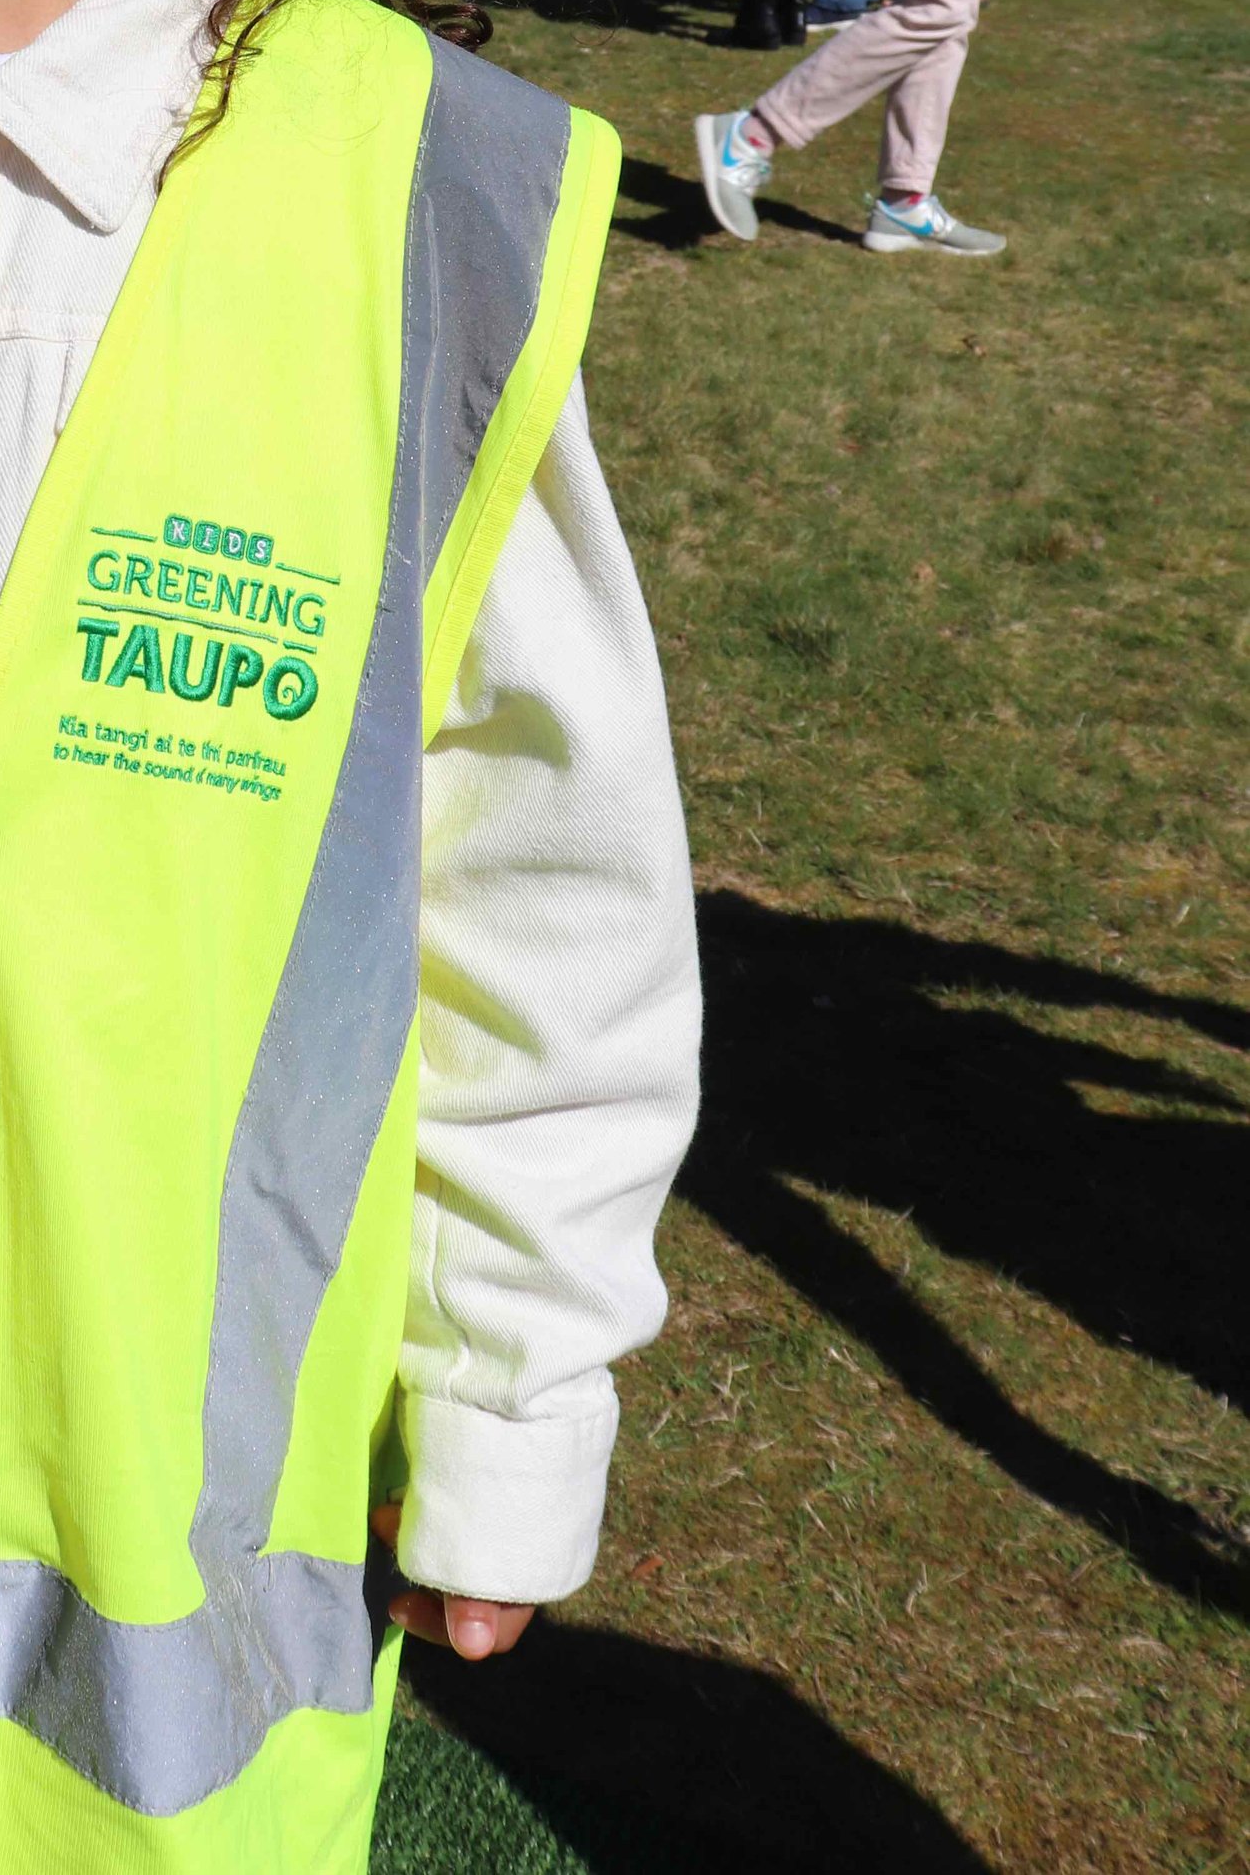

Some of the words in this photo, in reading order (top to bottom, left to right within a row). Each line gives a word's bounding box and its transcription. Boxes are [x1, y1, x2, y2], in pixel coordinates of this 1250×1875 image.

[168, 516, 270, 563] KIDS
[87, 549, 327, 637] GREENING
[58, 715, 88, 738] Kia
[95, 723, 149, 752] tangi
[154, 734, 173, 754] ai
[178, 739, 196, 757] te
[53, 743, 70, 760] to
[72, 745, 109, 766] hear
[114, 752, 141, 773] the
[143, 761, 195, 783] sound
[206, 772, 240, 794] many
[240, 775, 282, 802] wings
